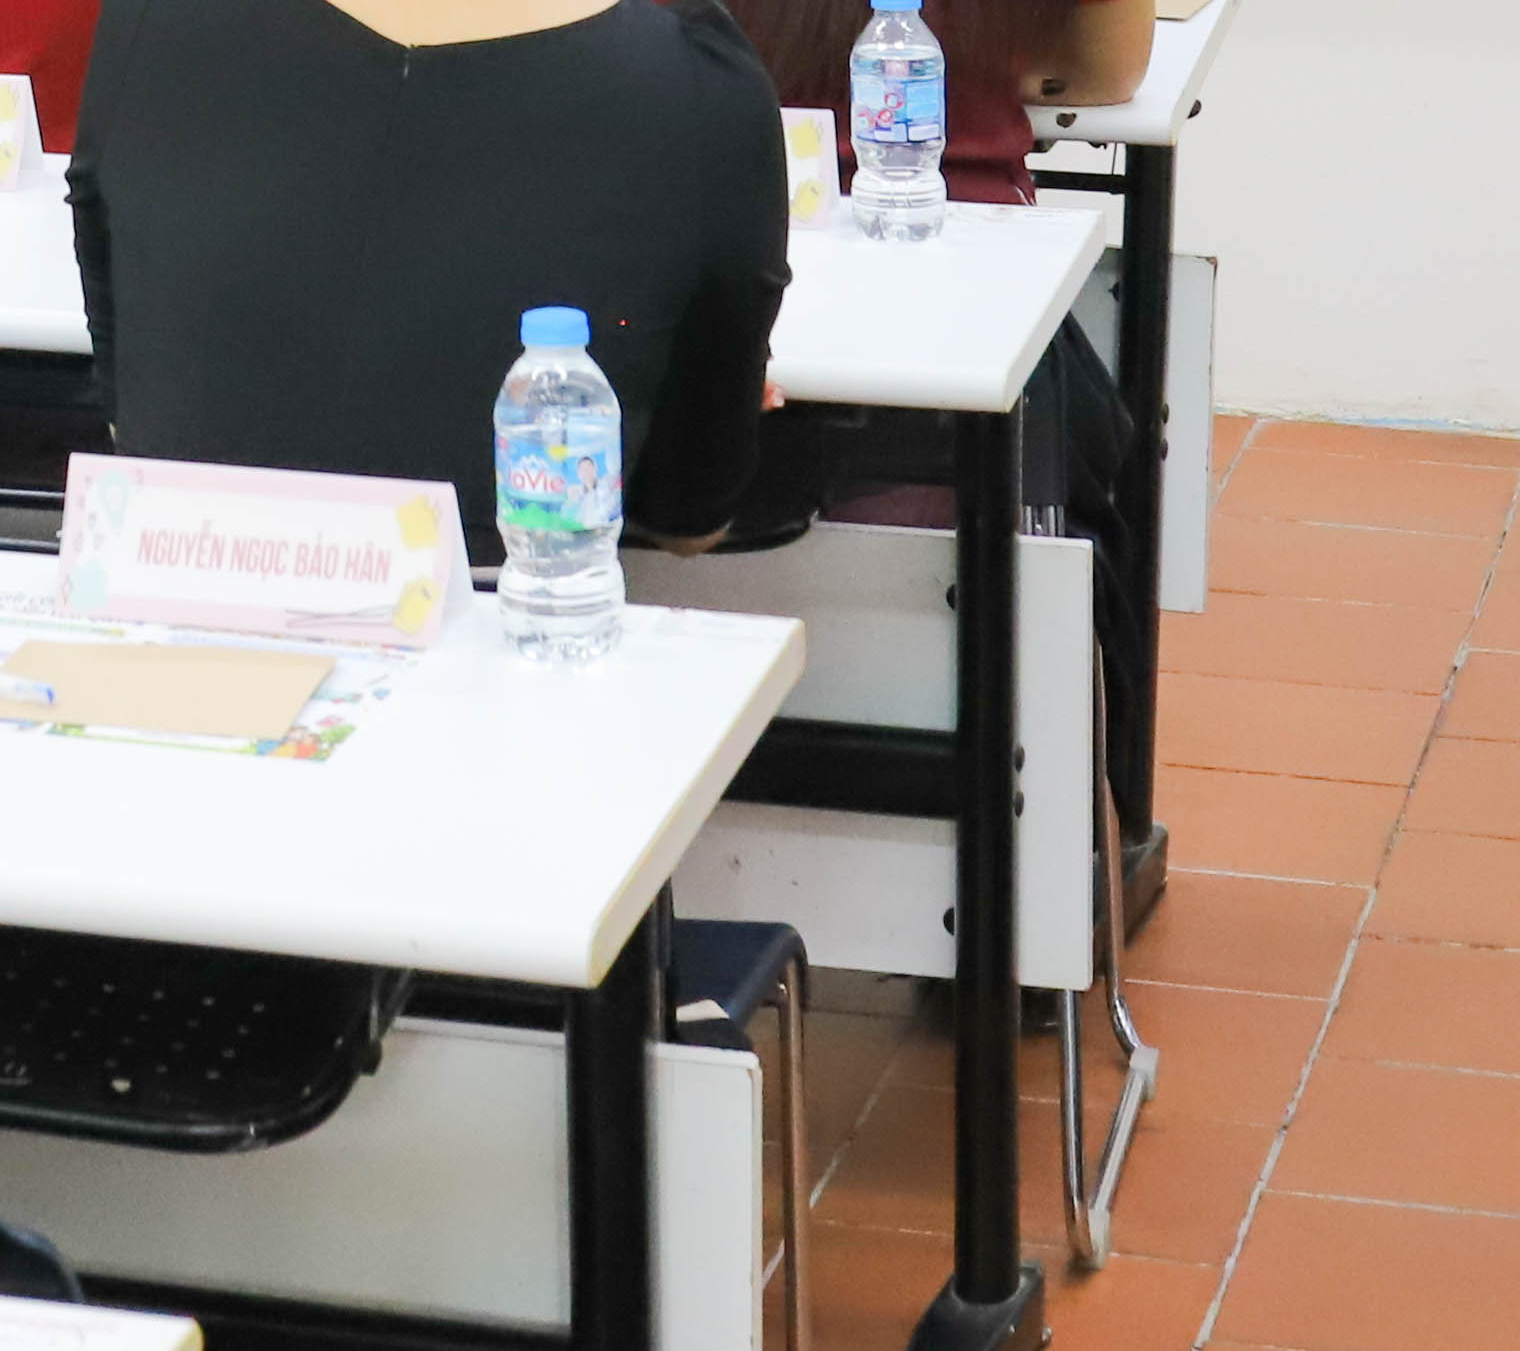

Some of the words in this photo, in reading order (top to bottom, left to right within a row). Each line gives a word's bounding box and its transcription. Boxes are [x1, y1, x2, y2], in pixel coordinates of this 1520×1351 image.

[137, 519, 226, 571] NGUYỄN
[230, 535, 289, 582] NGỌC
[293, 531, 340, 579] BẢO
[344, 540, 392, 584] HÂN
